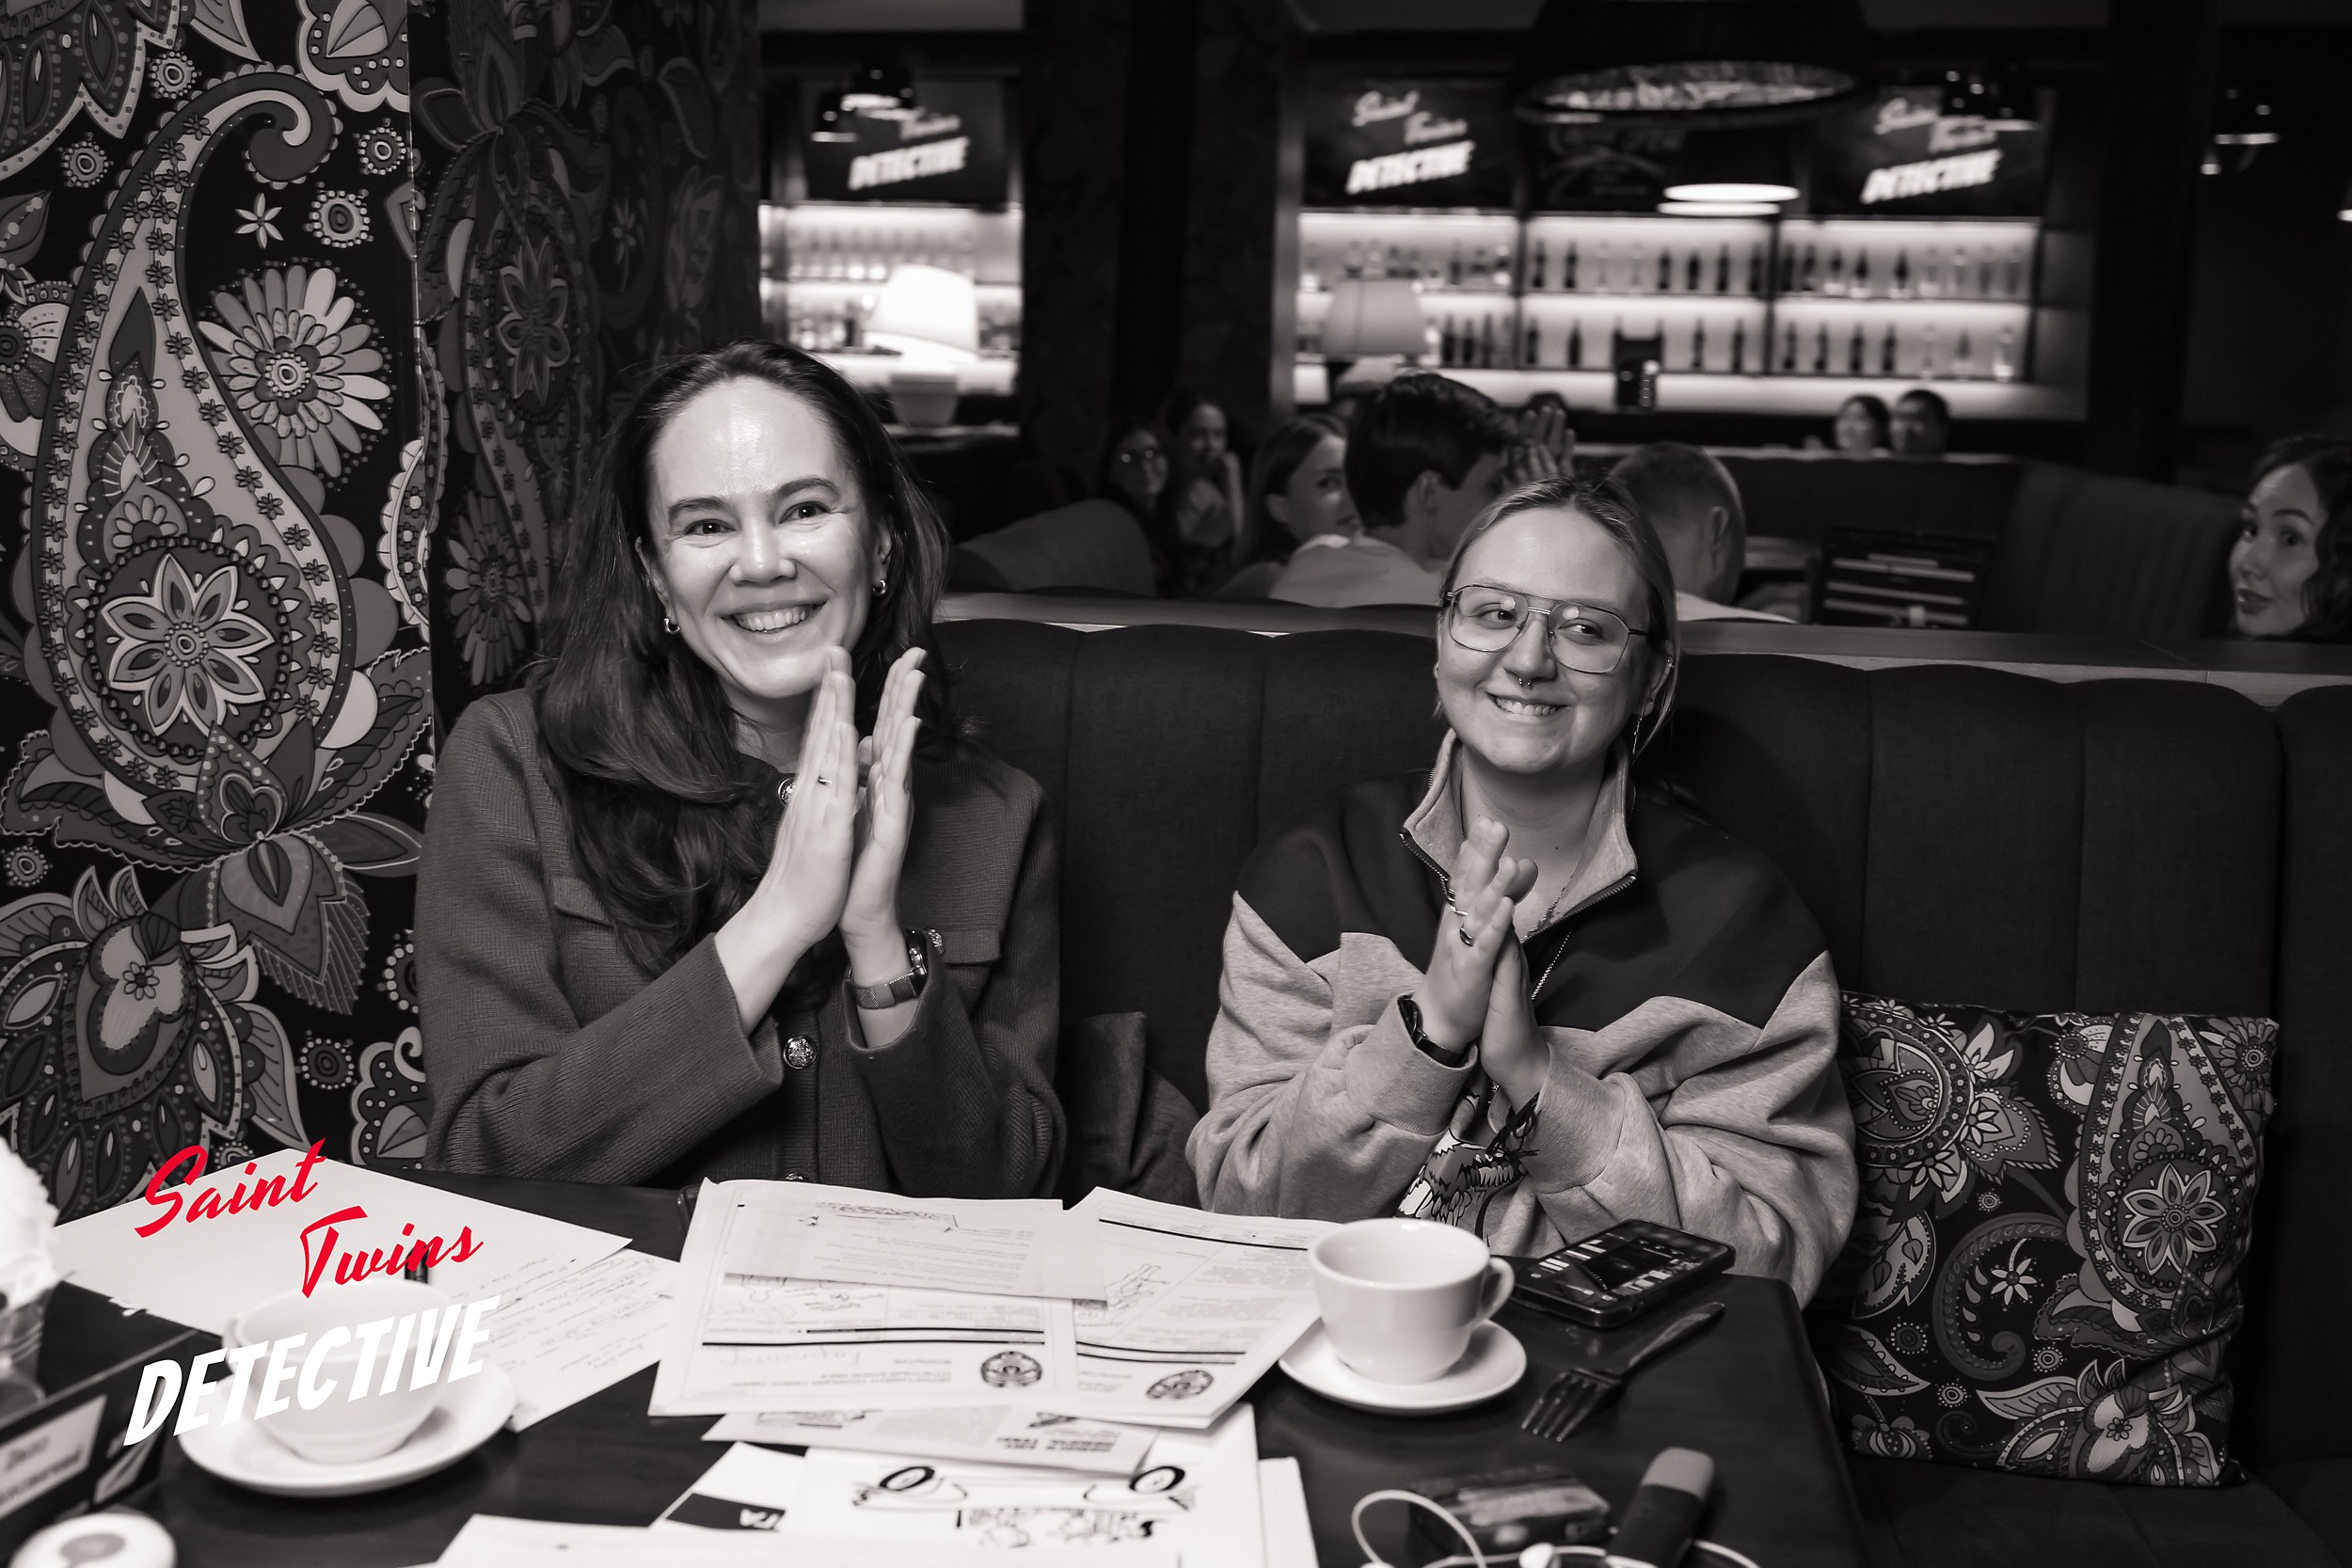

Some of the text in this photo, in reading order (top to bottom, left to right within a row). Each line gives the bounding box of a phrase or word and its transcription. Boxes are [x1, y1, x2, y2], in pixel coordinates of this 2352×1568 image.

[850, 135, 970, 190] DETECTIVE
[1346, 140, 1475, 194] DETECTIVE
[1862, 149, 2001, 204] DETECTIVE
